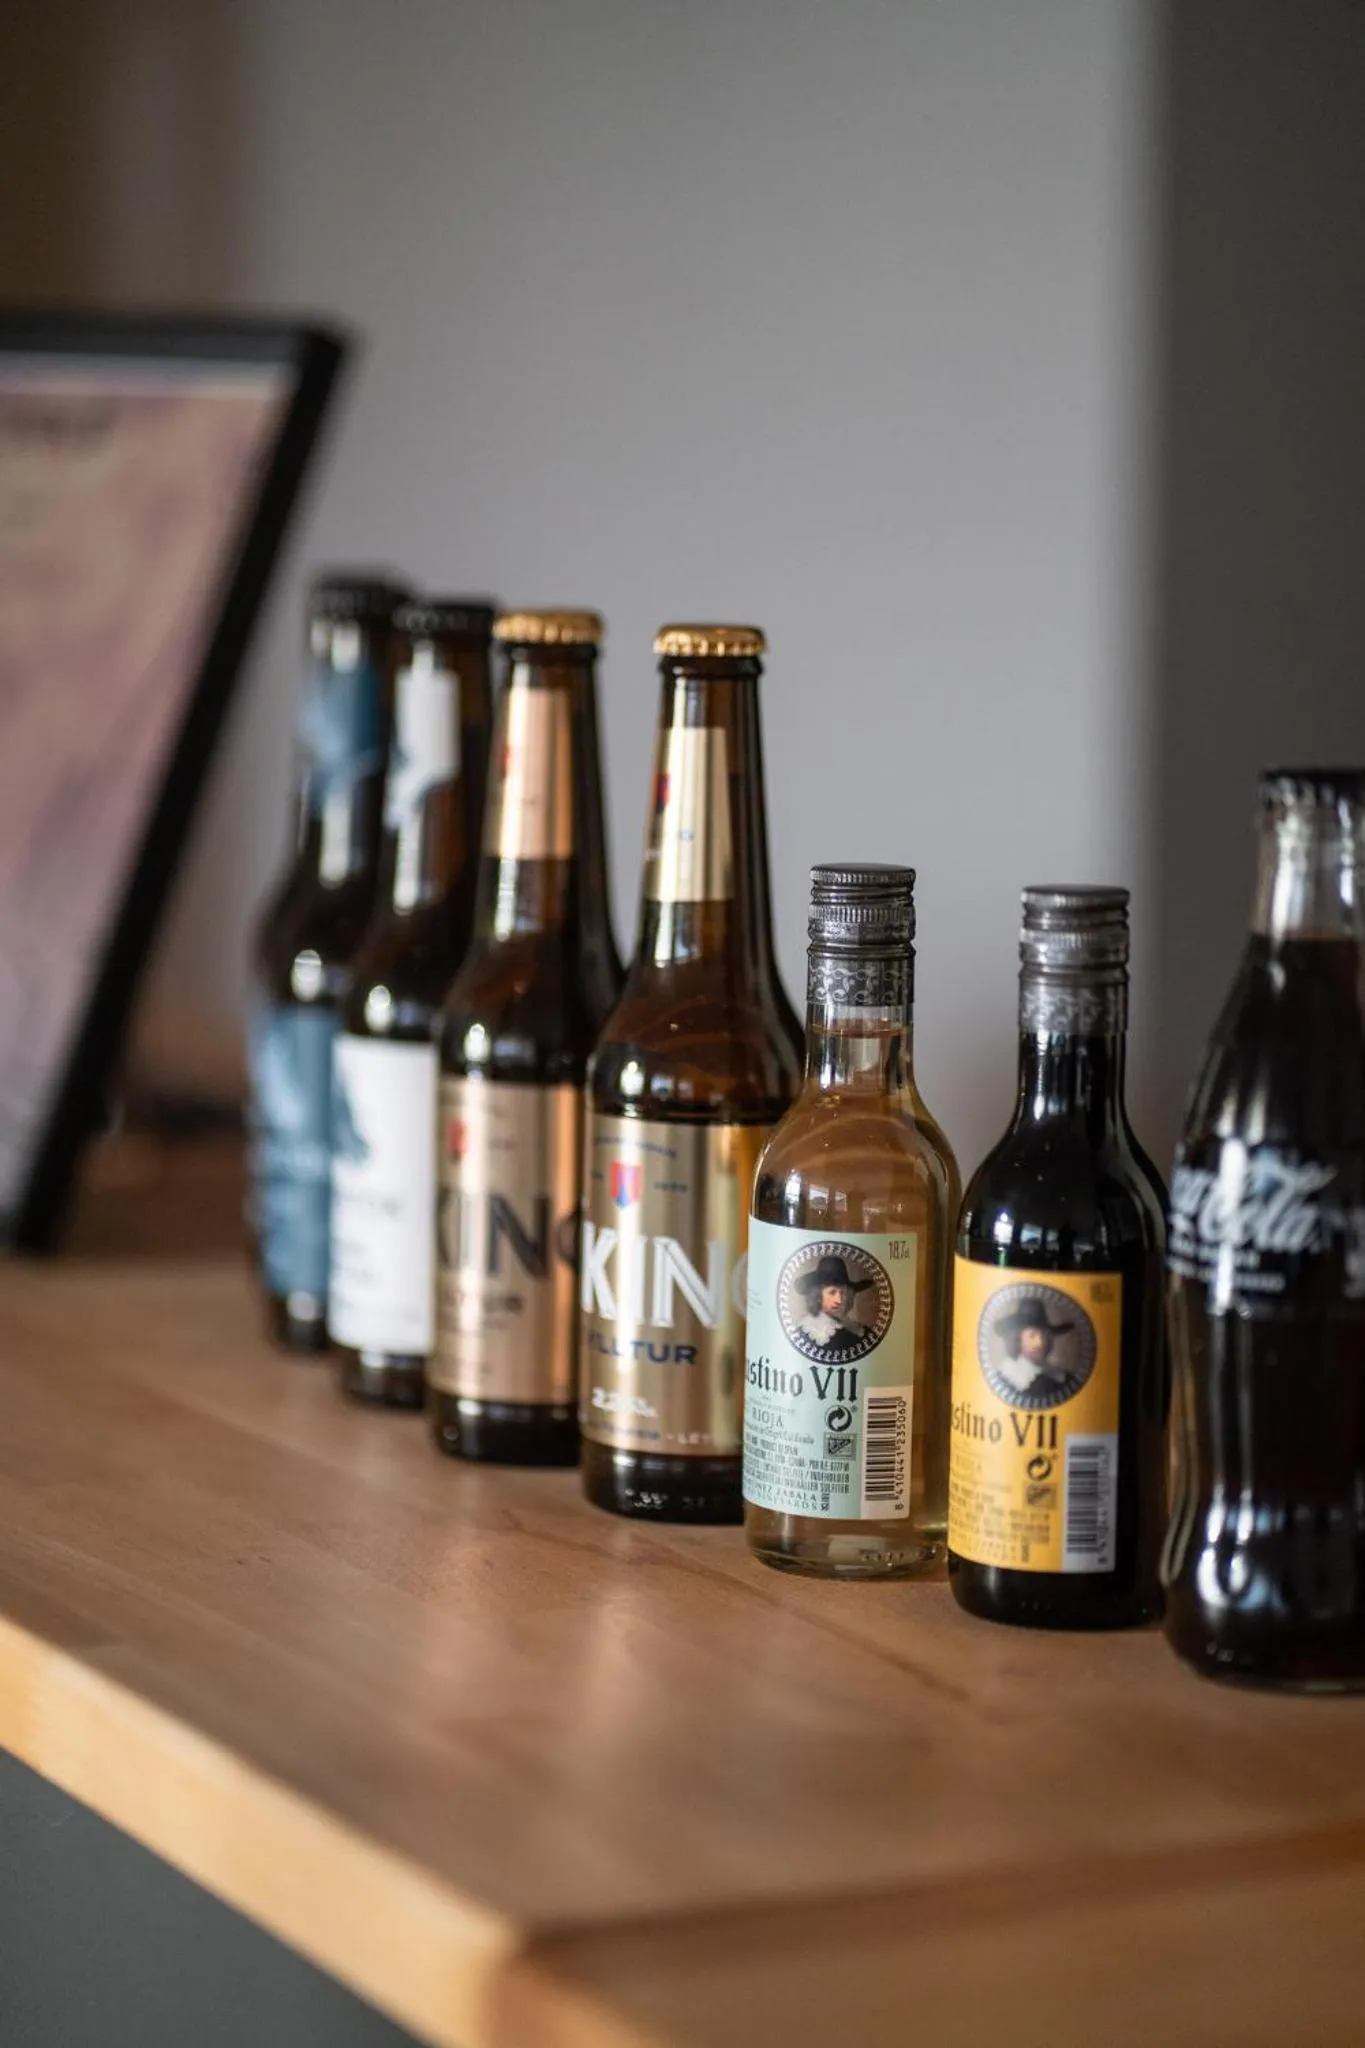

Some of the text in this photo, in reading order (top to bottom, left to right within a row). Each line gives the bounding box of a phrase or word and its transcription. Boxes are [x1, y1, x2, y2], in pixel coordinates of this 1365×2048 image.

[746, 1356, 858, 1402] stino VII
[751, 1406, 784, 1430] RIOJA
[895, 1400, 907, 1446] 235060
[951, 1401, 1059, 1450] stino VII
